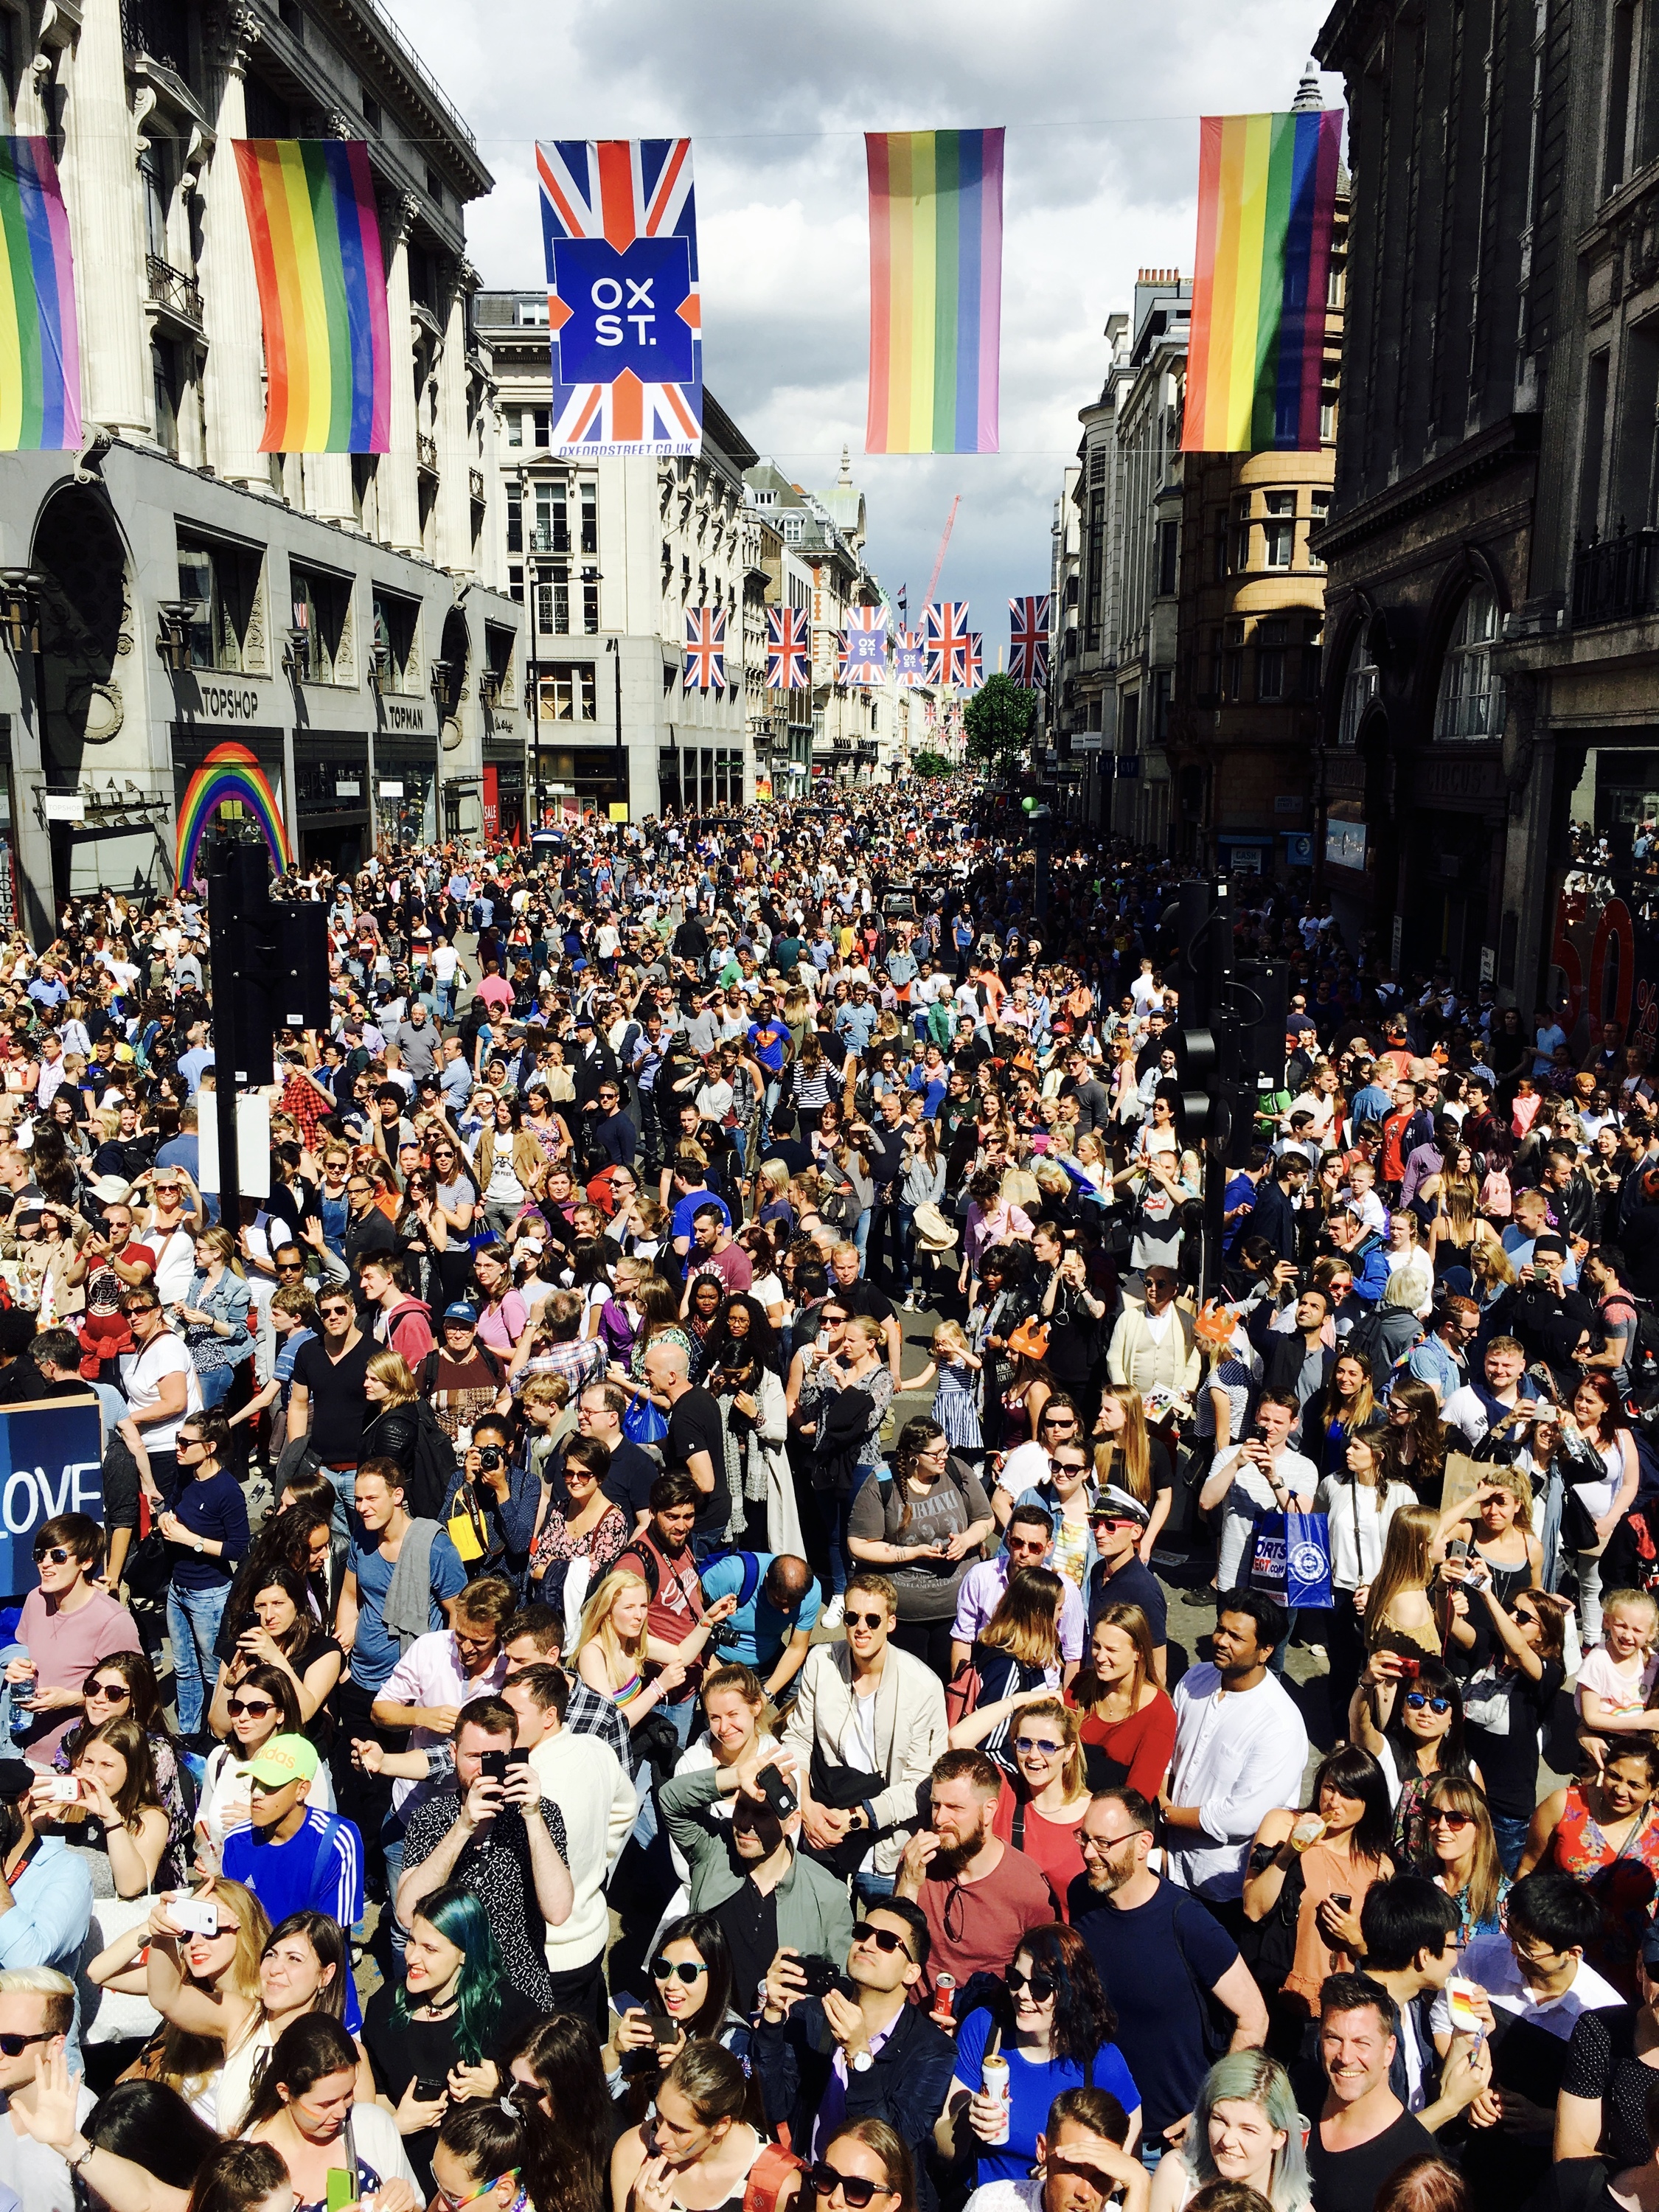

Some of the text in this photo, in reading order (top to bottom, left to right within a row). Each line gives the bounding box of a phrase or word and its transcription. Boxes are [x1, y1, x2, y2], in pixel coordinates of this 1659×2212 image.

[591, 277, 655, 310] OX
[595, 314, 657, 347] ST.
[559, 443, 693, 457] OXFORDSTREET.CO.UK
[858, 638, 876, 647] OX
[859, 647, 876, 656] ST.
[201, 686, 258, 720] TOPSHOP
[389, 706, 423, 731] TOPMAN
[1121, 762, 1135, 773] GAP
[1427, 762, 1482, 793] CIRCUS
[48, 804, 81, 812] TOPSHOP
[484, 804, 497, 821] SALE
[1236, 850, 1257, 860] CASH
[1547, 882, 1635, 1046] 50
[95, 1288, 118, 1298] 1979
[0, 1462, 104, 1539] OVE
[1297, 1548, 1311, 1558] BAG
[1297, 1565, 1311, 1579] LIFE
